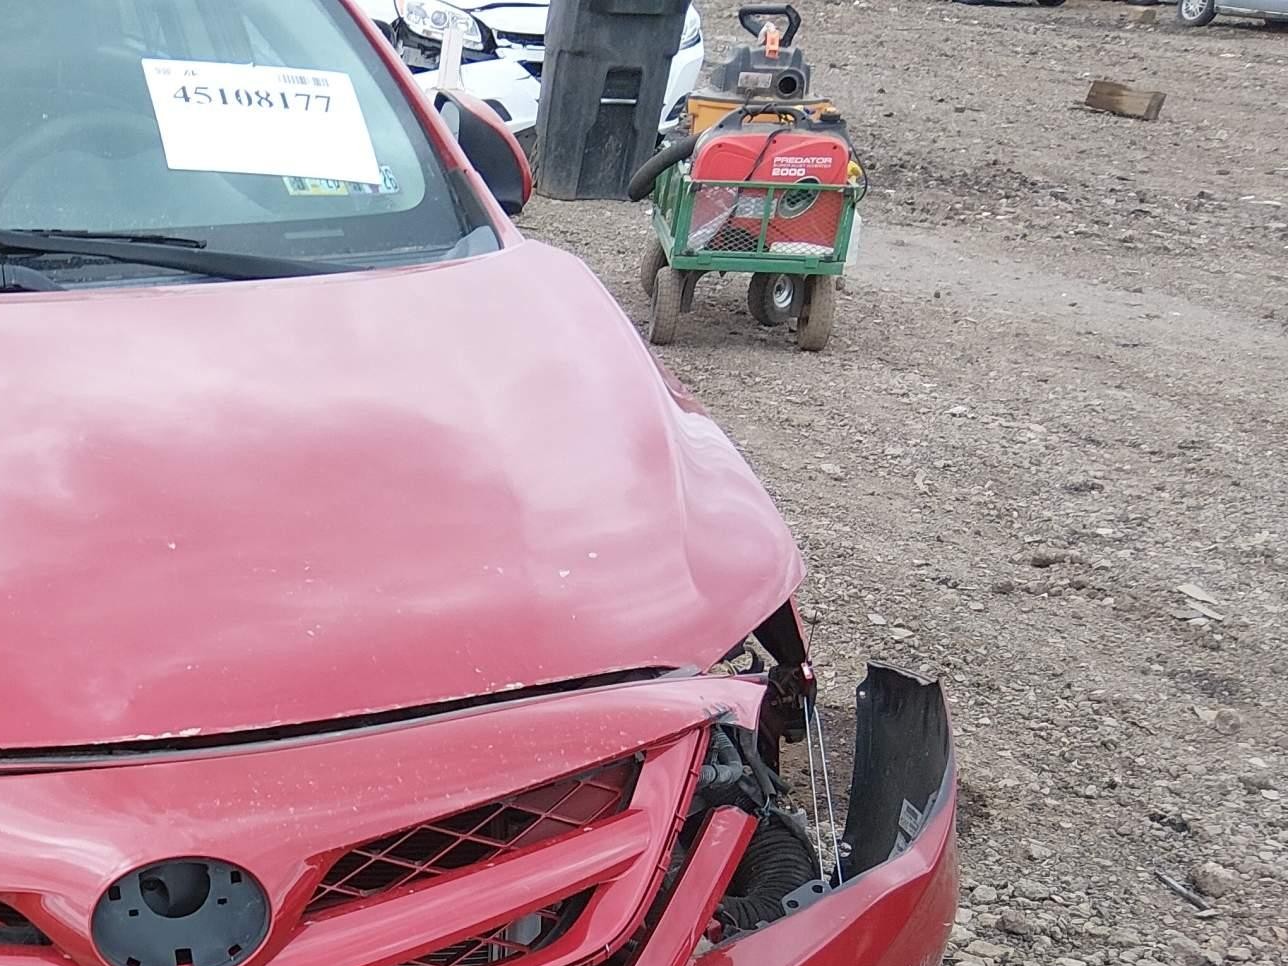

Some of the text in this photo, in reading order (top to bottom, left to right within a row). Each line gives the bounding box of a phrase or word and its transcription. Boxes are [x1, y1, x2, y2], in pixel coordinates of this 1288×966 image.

[173, 86, 331, 113] 45108177
[774, 156, 832, 164] PREDATOR
[772, 168, 805, 176] 2000
